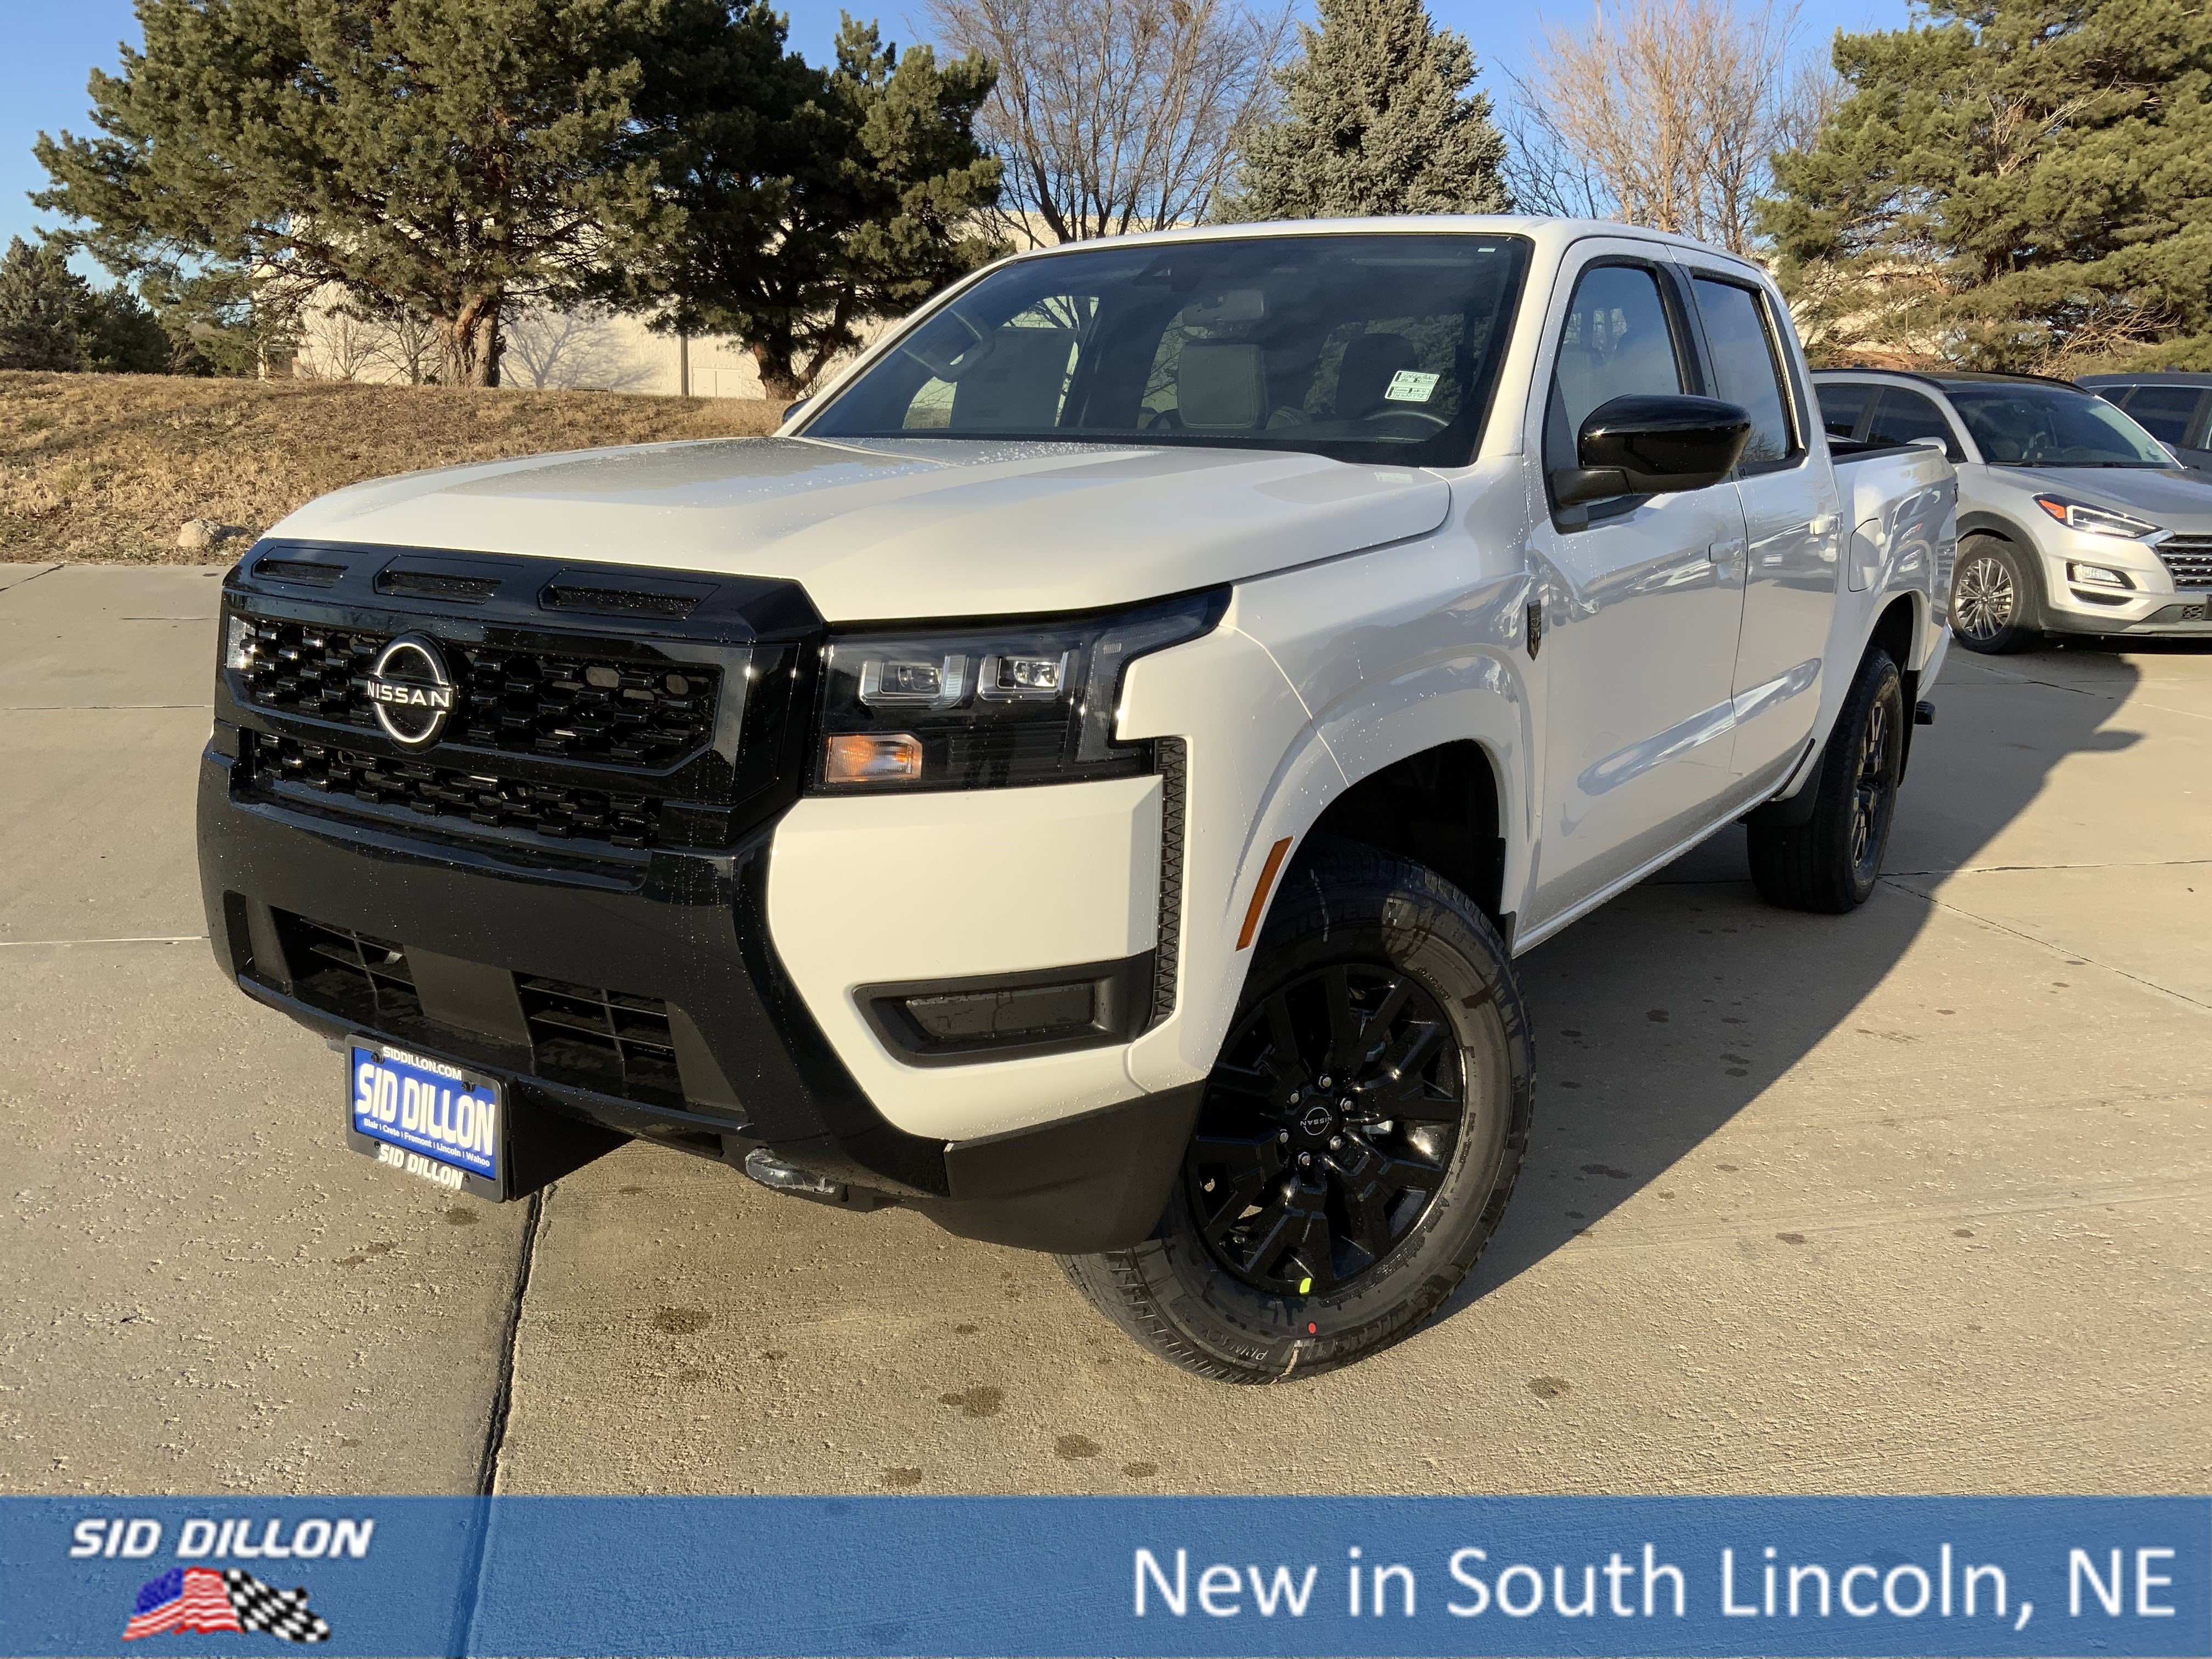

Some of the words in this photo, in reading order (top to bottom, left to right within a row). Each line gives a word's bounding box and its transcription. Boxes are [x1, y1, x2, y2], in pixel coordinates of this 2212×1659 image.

[367, 680, 449, 708] NISSAN
[382, 1046, 462, 1081] SIDDILLON.COM
[357, 1063, 398, 1123] SID
[402, 1076, 495, 1156] DILLON
[1300, 1116, 1332, 1126] NISSAN
[364, 1118, 379, 1130] Blair
[383, 1124, 400, 1137] Crete
[404, 1132, 432, 1148] Fremont
[437, 1143, 461, 1158] Lincoln
[466, 1152, 490, 1167] Wahoo
[379, 1143, 405, 1168] SID
[407, 1153, 464, 1190] DILLON
